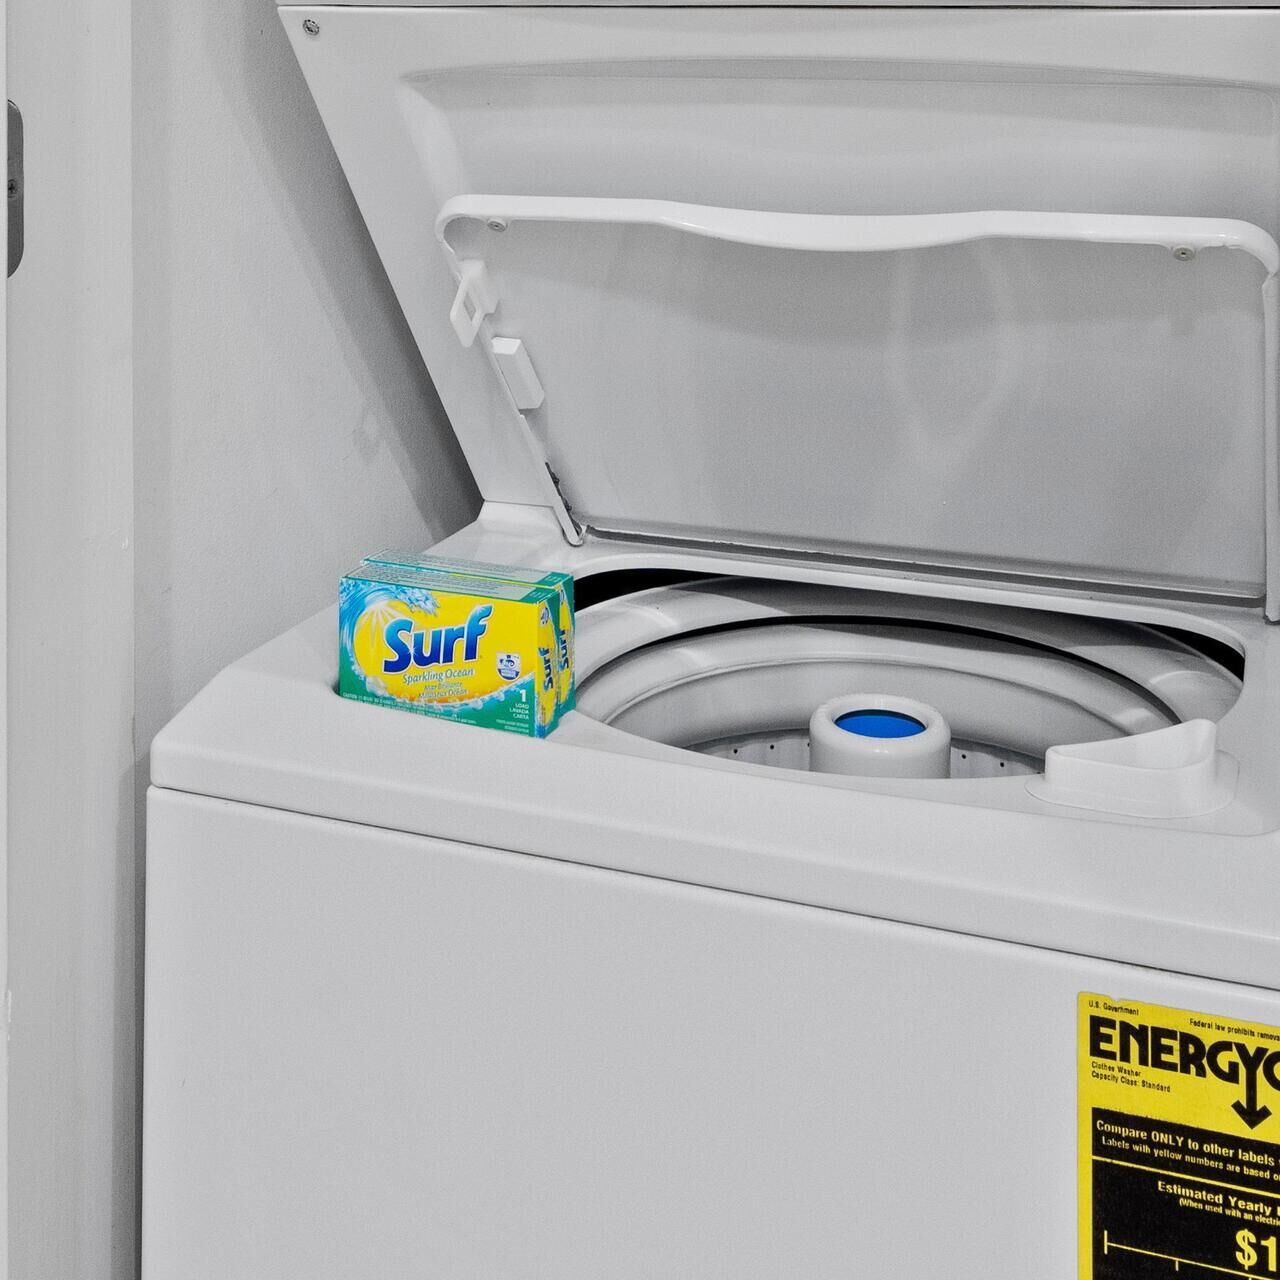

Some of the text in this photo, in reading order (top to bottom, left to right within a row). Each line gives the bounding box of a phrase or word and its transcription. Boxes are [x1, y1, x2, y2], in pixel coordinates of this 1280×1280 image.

[383, 605, 493, 672] Surf
[403, 668, 474, 686] Sparkling Ocean
[538, 647, 554, 693] Surf
[519, 689, 527, 702] 1
[1103, 1003, 1139, 1015] Government
[1190, 1017, 1213, 1029] Federal
[1215, 1023, 1226, 1032] law
[1227, 1026, 1255, 1037] prohibits
[1092, 1062, 1141, 1077] Clothes Washer
[1091, 1071, 1170, 1092] Capacity Standard
[1097, 1120, 1147, 1139] Compare
[1152, 1131, 1184, 1146] ONLY
[1188, 1139, 1199, 1150] to
[1203, 1144, 1234, 1158] other
[1240, 1149, 1274, 1167] labels
[1102, 1136, 1130, 1149] Labels
[1133, 1143, 1151, 1154] with
[1154, 1148, 1182, 1160] yellow
[1185, 1155, 1223, 1169] numbers
[1226, 1164, 1240, 1173] are
[1244, 1166, 1270, 1179] based
[1158, 1181, 1223, 1204] Estimated
[1228, 1196, 1272, 1216] Yearly
[1179, 1198, 1203, 1210] (When
[1205, 1204, 1223, 1214] used
[1225, 1207, 1241, 1218] with
[1243, 1211, 1253, 1220] an
